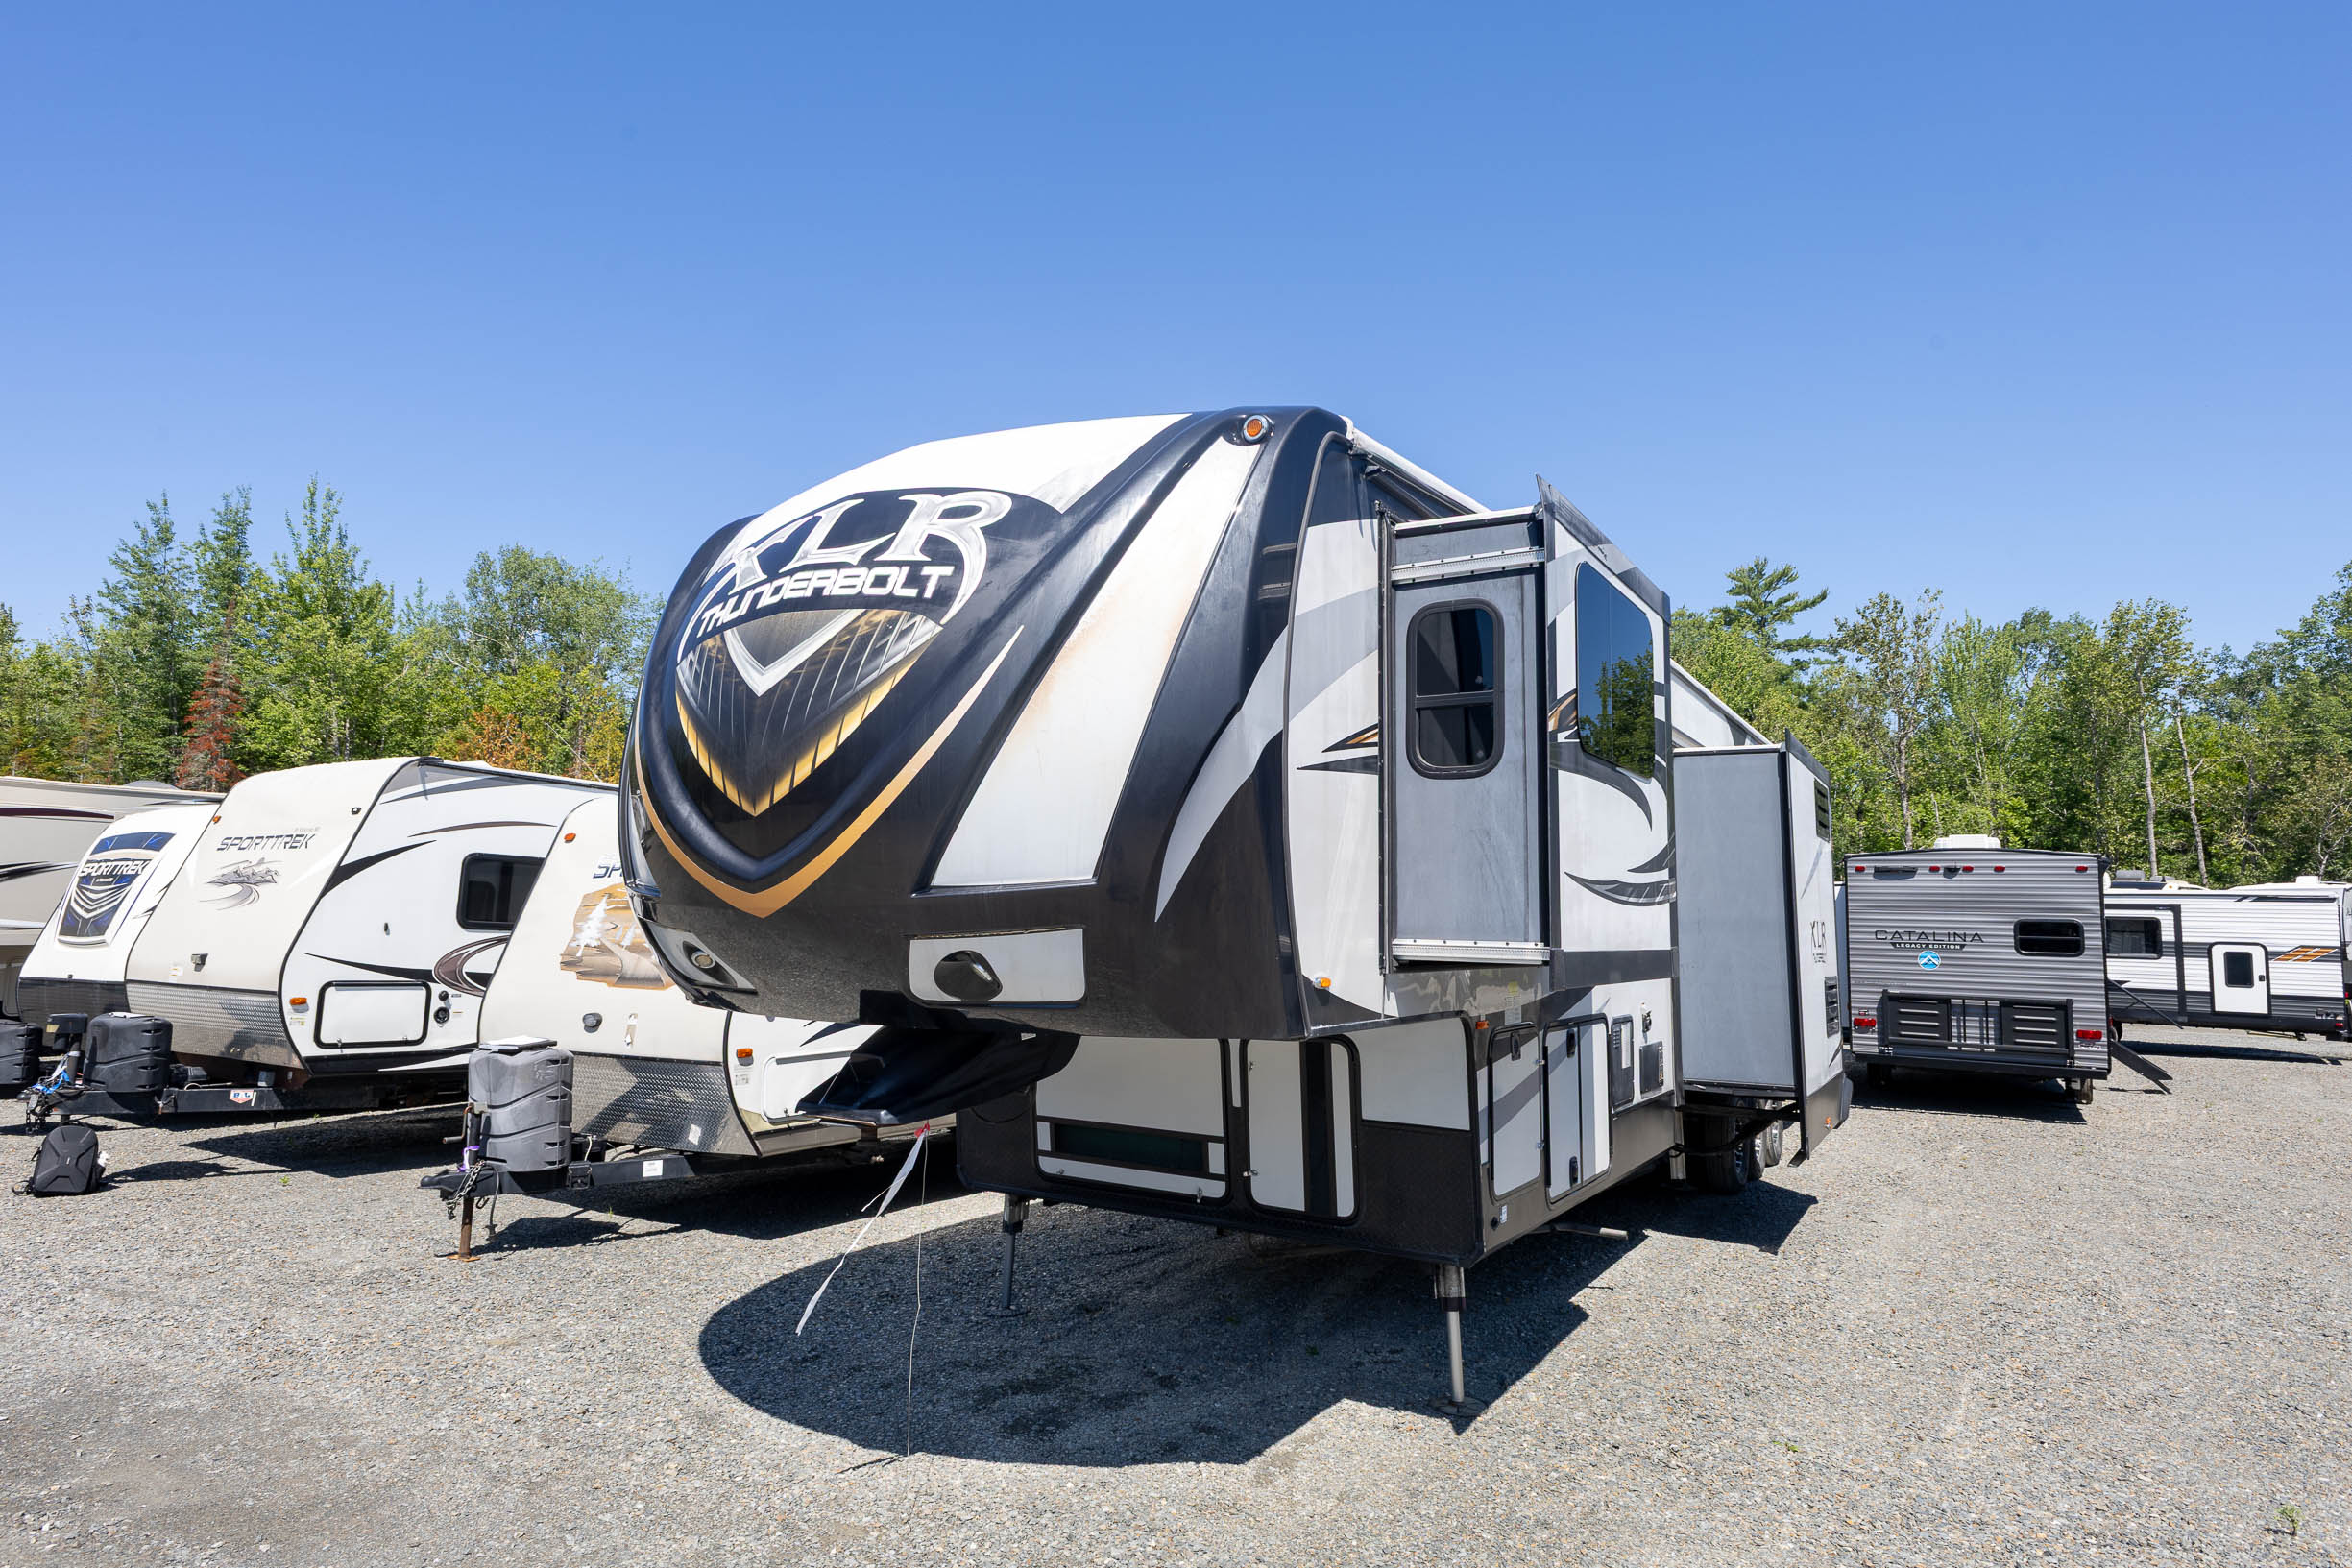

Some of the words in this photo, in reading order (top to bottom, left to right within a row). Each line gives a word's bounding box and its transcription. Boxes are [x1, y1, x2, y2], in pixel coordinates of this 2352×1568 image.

[677, 491, 1013, 663] XLR
[696, 566, 956, 639] THUNDERBOLT
[216, 833, 316, 852] SPORTTREK
[78, 860, 151, 877] SPORTTREK
[1809, 920, 1827, 949] XLR
[1874, 929, 1985, 943] CATALINA
